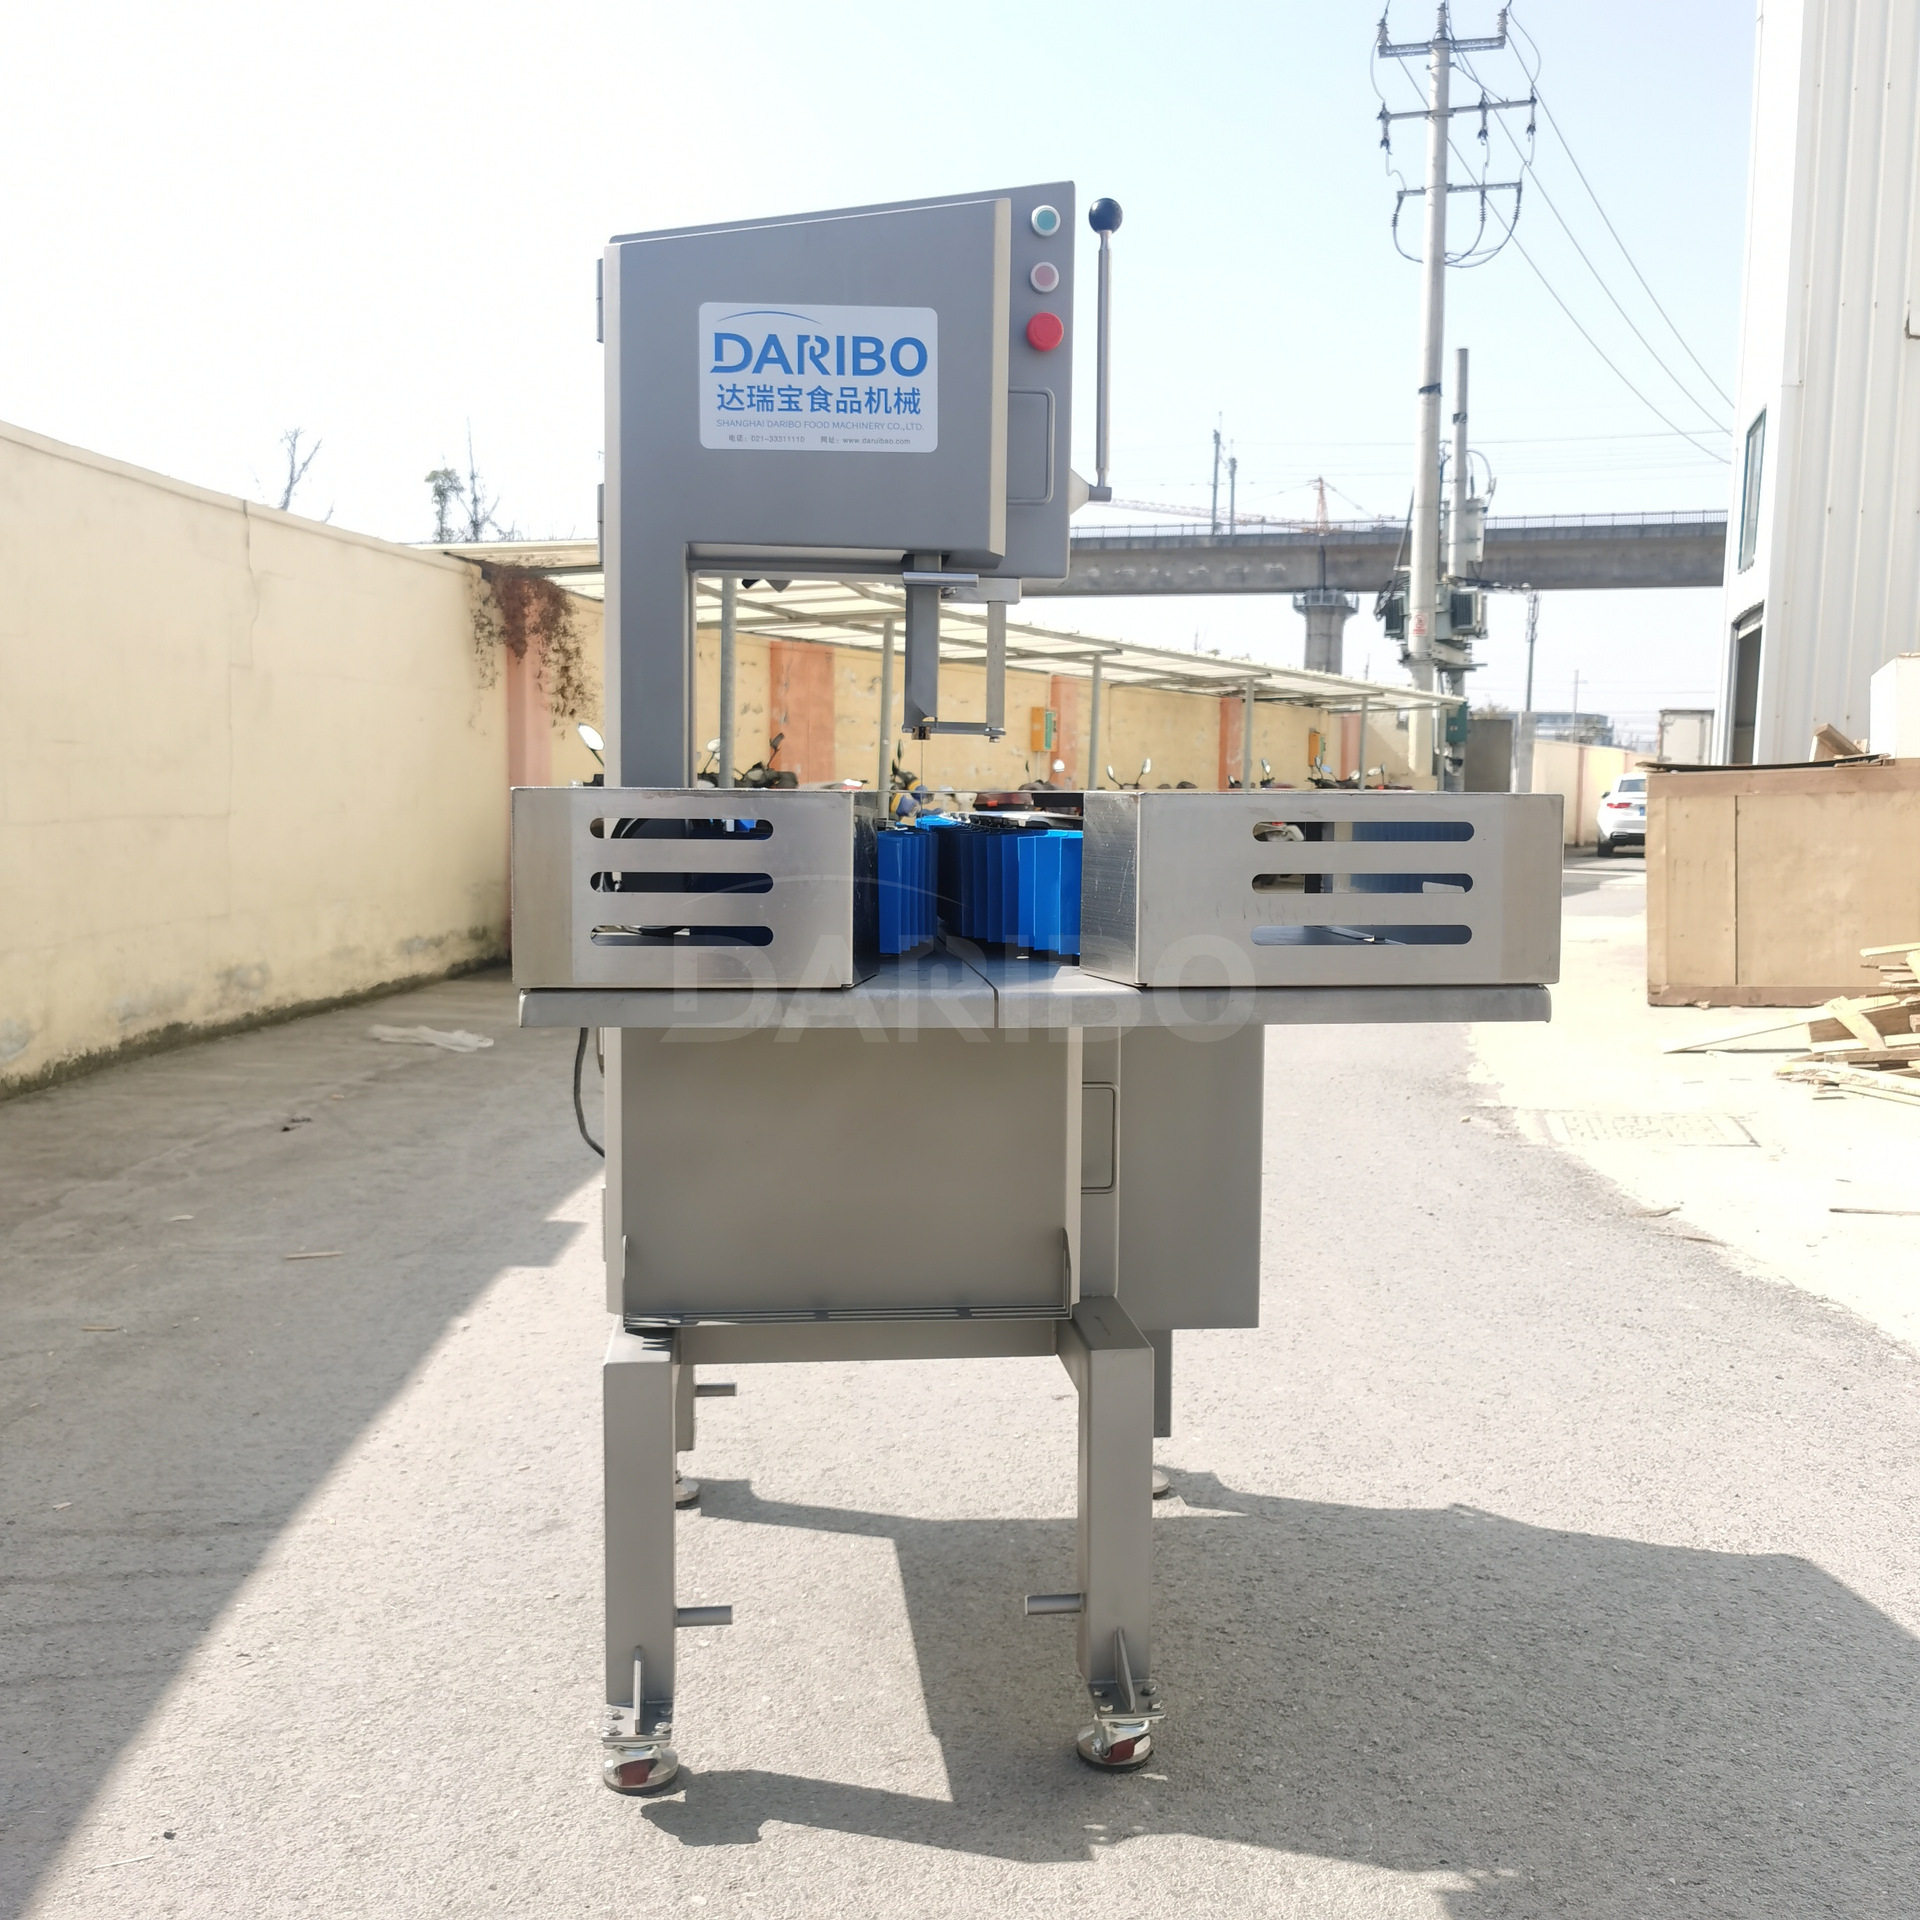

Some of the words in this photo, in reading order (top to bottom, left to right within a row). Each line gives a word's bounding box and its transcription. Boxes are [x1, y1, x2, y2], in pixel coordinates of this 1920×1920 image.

[710, 332, 928, 377] DARIBO
[717, 383, 921, 415] 达瑞宝食品机械
[716, 419, 765, 428] SHANGHAI
[767, 420, 802, 428] DARIBO
[804, 421, 830, 429] FOOD
[833, 421, 885, 430] MACHINERY
